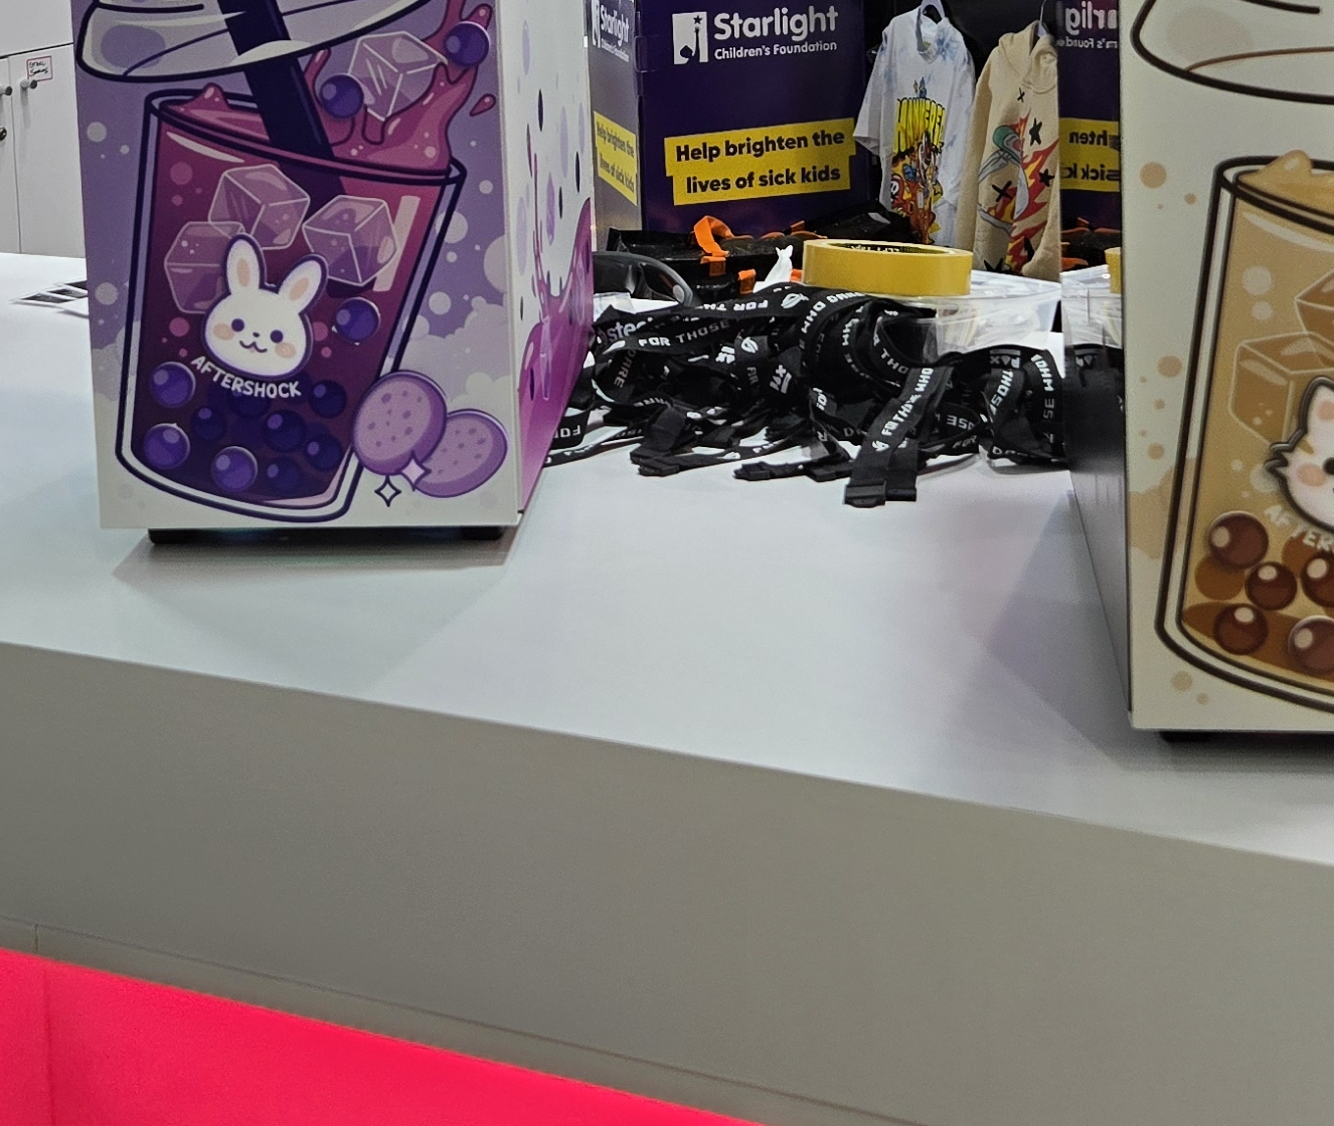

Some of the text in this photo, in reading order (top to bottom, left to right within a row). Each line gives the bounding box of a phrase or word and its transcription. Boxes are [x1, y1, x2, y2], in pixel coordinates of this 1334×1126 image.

[599, 3, 630, 47] Starlight
[713, 5, 839, 42] Starlight
[714, 40, 838, 61] Children's Foundation
[675, 129, 845, 163] Help brighten the
[686, 164, 841, 194] lives of sick kids
[638, 319, 731, 347] FOR THOSE
[190, 355, 303, 399] AFTERSHOCK
[914, 367, 934, 392] WHO
